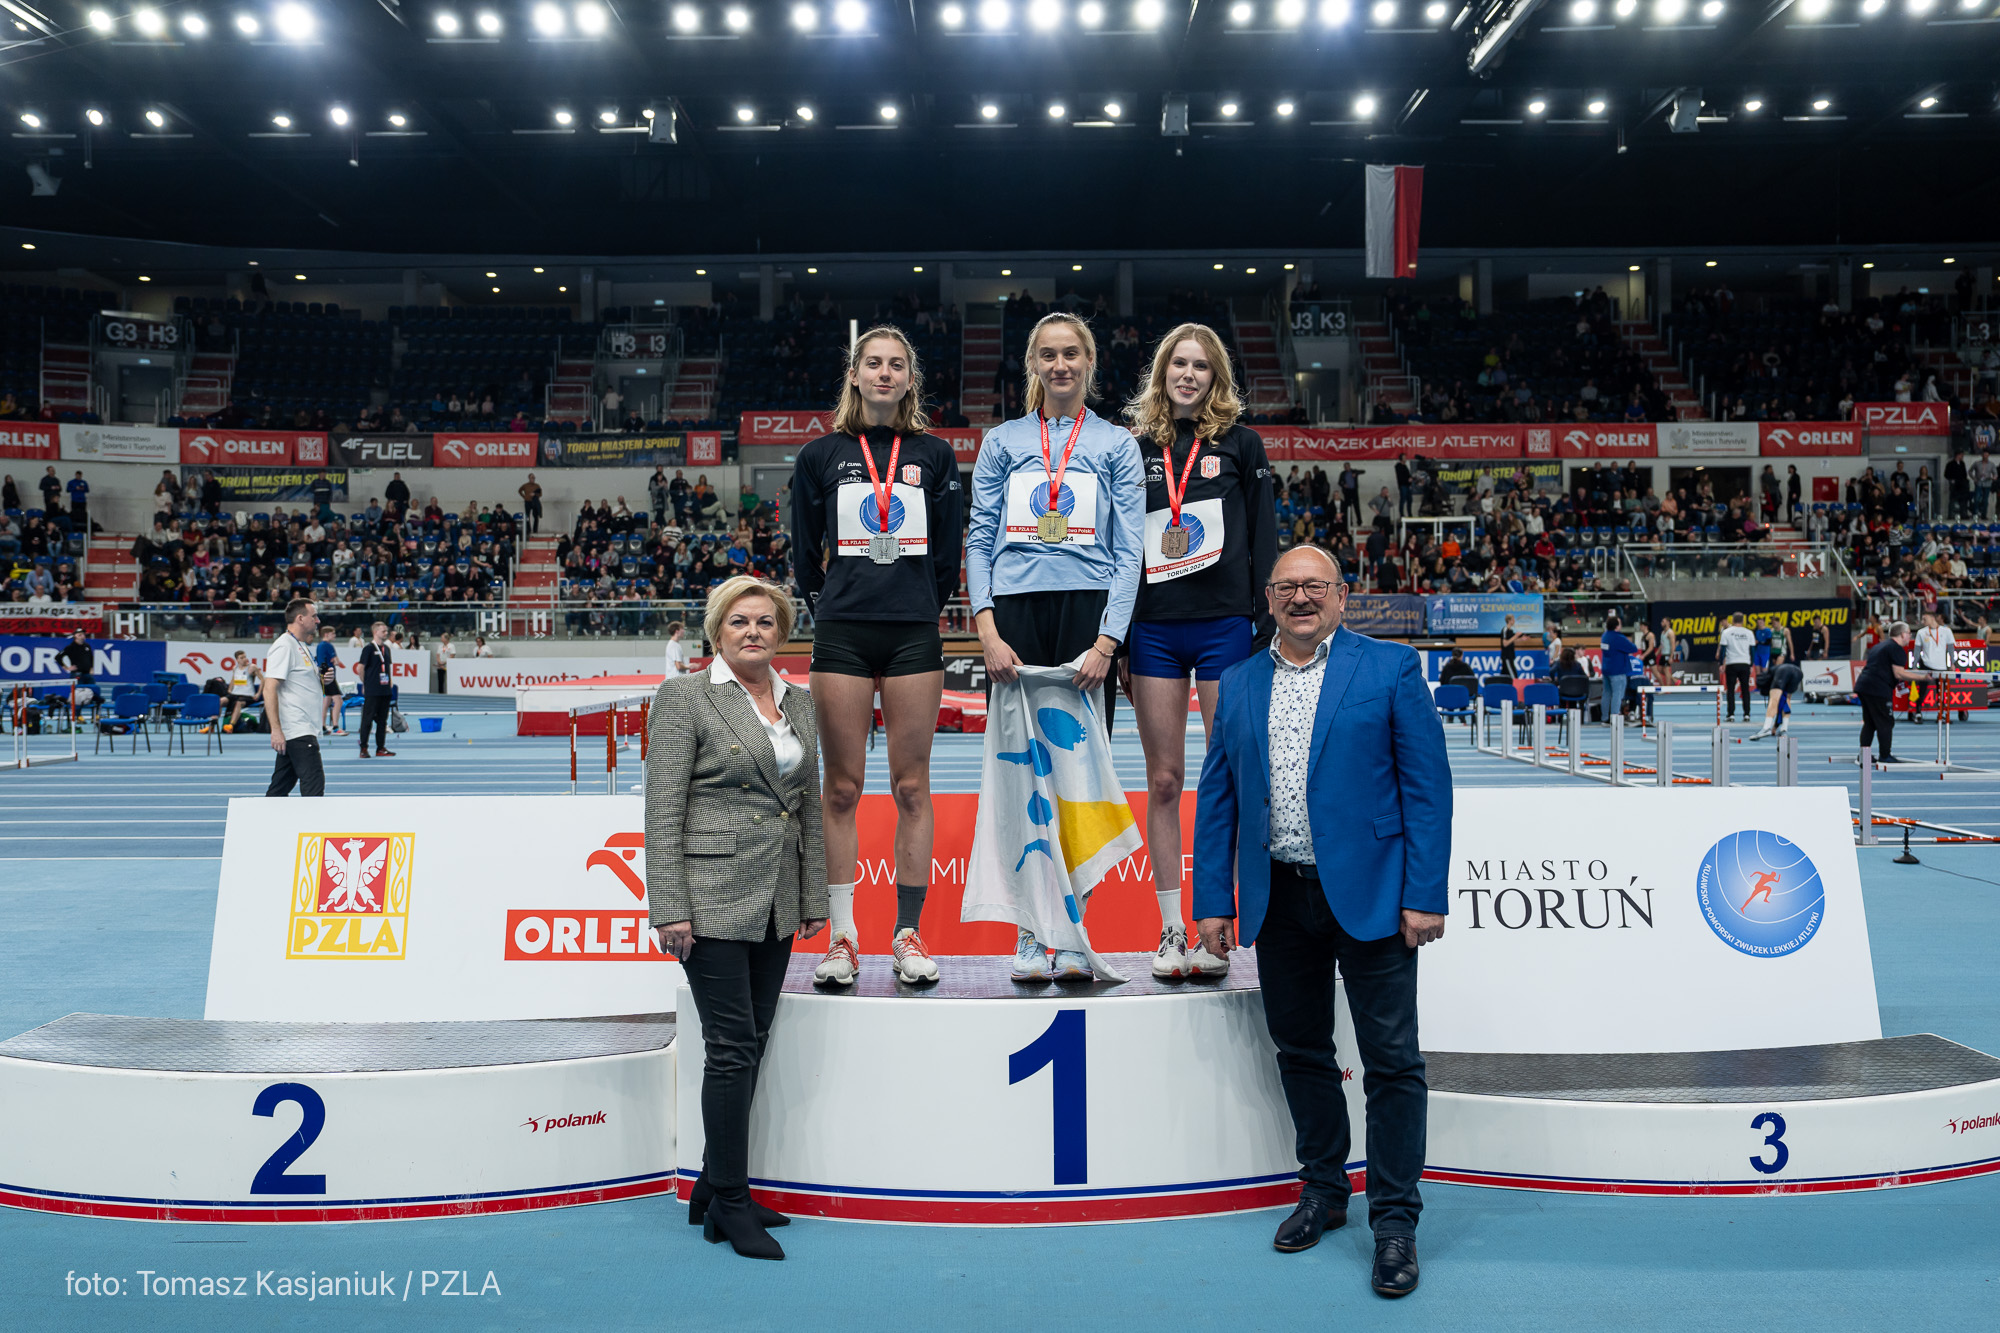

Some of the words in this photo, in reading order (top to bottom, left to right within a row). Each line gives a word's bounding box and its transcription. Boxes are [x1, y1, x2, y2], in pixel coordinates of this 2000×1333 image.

[1291, 312, 1313, 330] J3
[1320, 312, 1346, 330] K3
[106, 322, 138, 341] G3
[149, 325, 178, 343] H3
[753, 416, 825, 433] PZLA
[1866, 407, 1938, 425] PZLA
[0, 431, 50, 448] RLEN
[224, 440, 285, 454] ORLEN
[340, 438, 364, 449] 4F
[601, 438, 643, 451] MIASTEM
[644, 437, 680, 449] SPORTU
[1263, 437, 1289, 448] SKI
[1294, 437, 1369, 452] ZWIĄZEK
[1373, 436, 1436, 448] LEKKIEJ
[1441, 436, 1515, 448] ATLETYKI
[1595, 433, 1650, 447] ORLEN
[1798, 432, 1853, 445] ORLEN
[361, 443, 422, 460] FUEL
[474, 443, 530, 456] ORLEN
[252, 474, 302, 487] MIASTEM
[1189, 562, 1205, 572] 2024
[1800, 551, 1826, 572] K1
[1366, 600, 1390, 609] PZLA
[1450, 603, 1478, 613] IRENY
[1480, 602, 1540, 614] SZEWIŃSKIEJ
[114, 612, 145, 635] H1
[480, 611, 507, 632] H1
[1386, 611, 1420, 620] POLSKI
[1443, 617, 1479, 626] CZERWCA
[1790, 607, 1848, 629] SPORTU
[0, 643, 121, 676] ORŃ
[945, 659, 975, 675] 4F
[1683, 672, 1719, 685] FUEL
[1466, 859, 1608, 881] MIASTO
[1458, 876, 1655, 930] TORUŃ
[1700, 863, 1735, 943] KUJAWSKO-POMORSKI
[1734, 938, 1769, 955] ZWIĄZEK
[1770, 938, 1800, 955] LEKKIEJ
[1798, 911, 1820, 942] ATLETYKI
[293, 917, 399, 954] PZLA
[1008, 1008, 1088, 1185] 1
[544, 1109, 608, 1134] polanik
[250, 1082, 327, 1195] 2
[1749, 1111, 1790, 1175] 3
